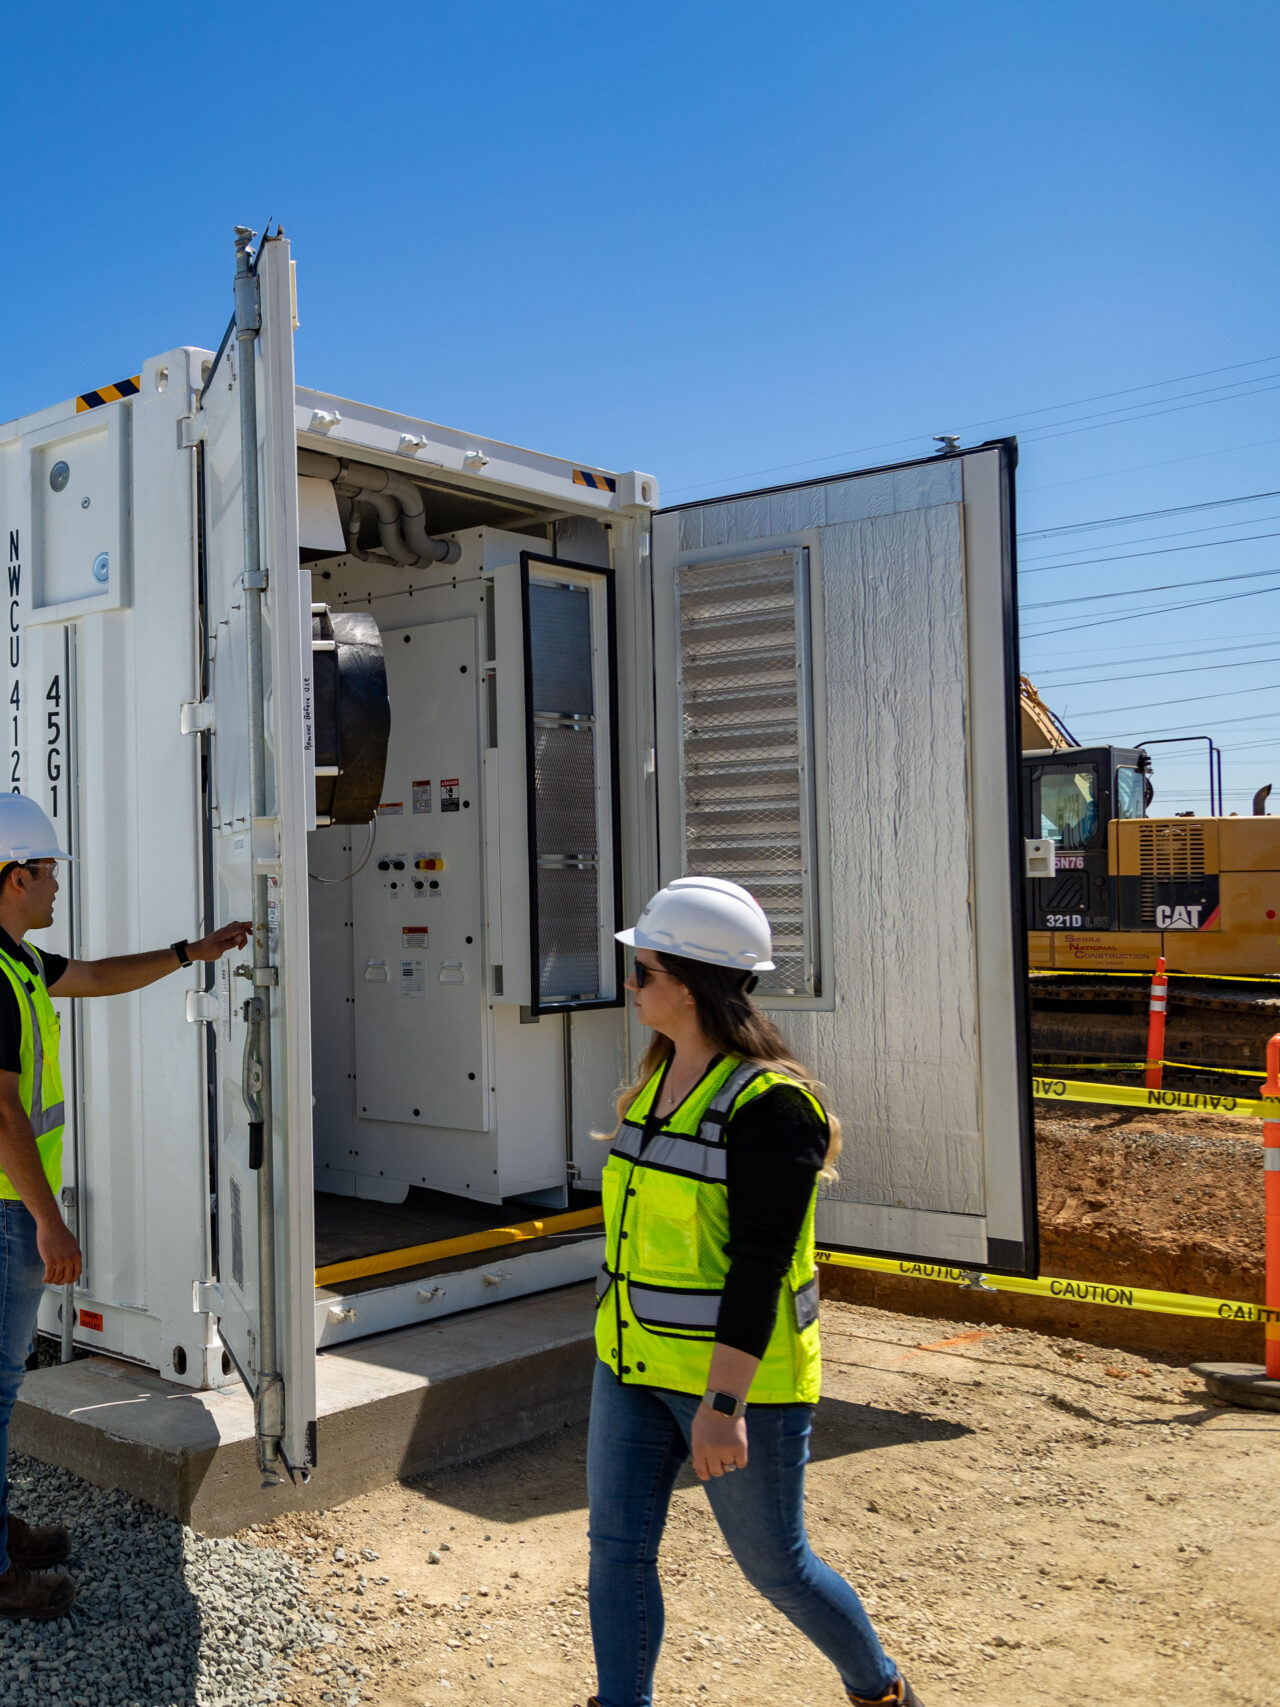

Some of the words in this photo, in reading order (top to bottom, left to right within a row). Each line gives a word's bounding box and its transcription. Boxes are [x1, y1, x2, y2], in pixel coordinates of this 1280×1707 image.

[8, 529, 21, 668] NWCU
[9, 679, 21, 796] 412
[46, 675, 62, 818] 45G1
[1046, 914, 1082, 927] 321D
[1156, 905, 1202, 929] CAT
[1148, 1090, 1237, 1112] CAUTION
[1050, 1280, 1133, 1305] CAUTION
